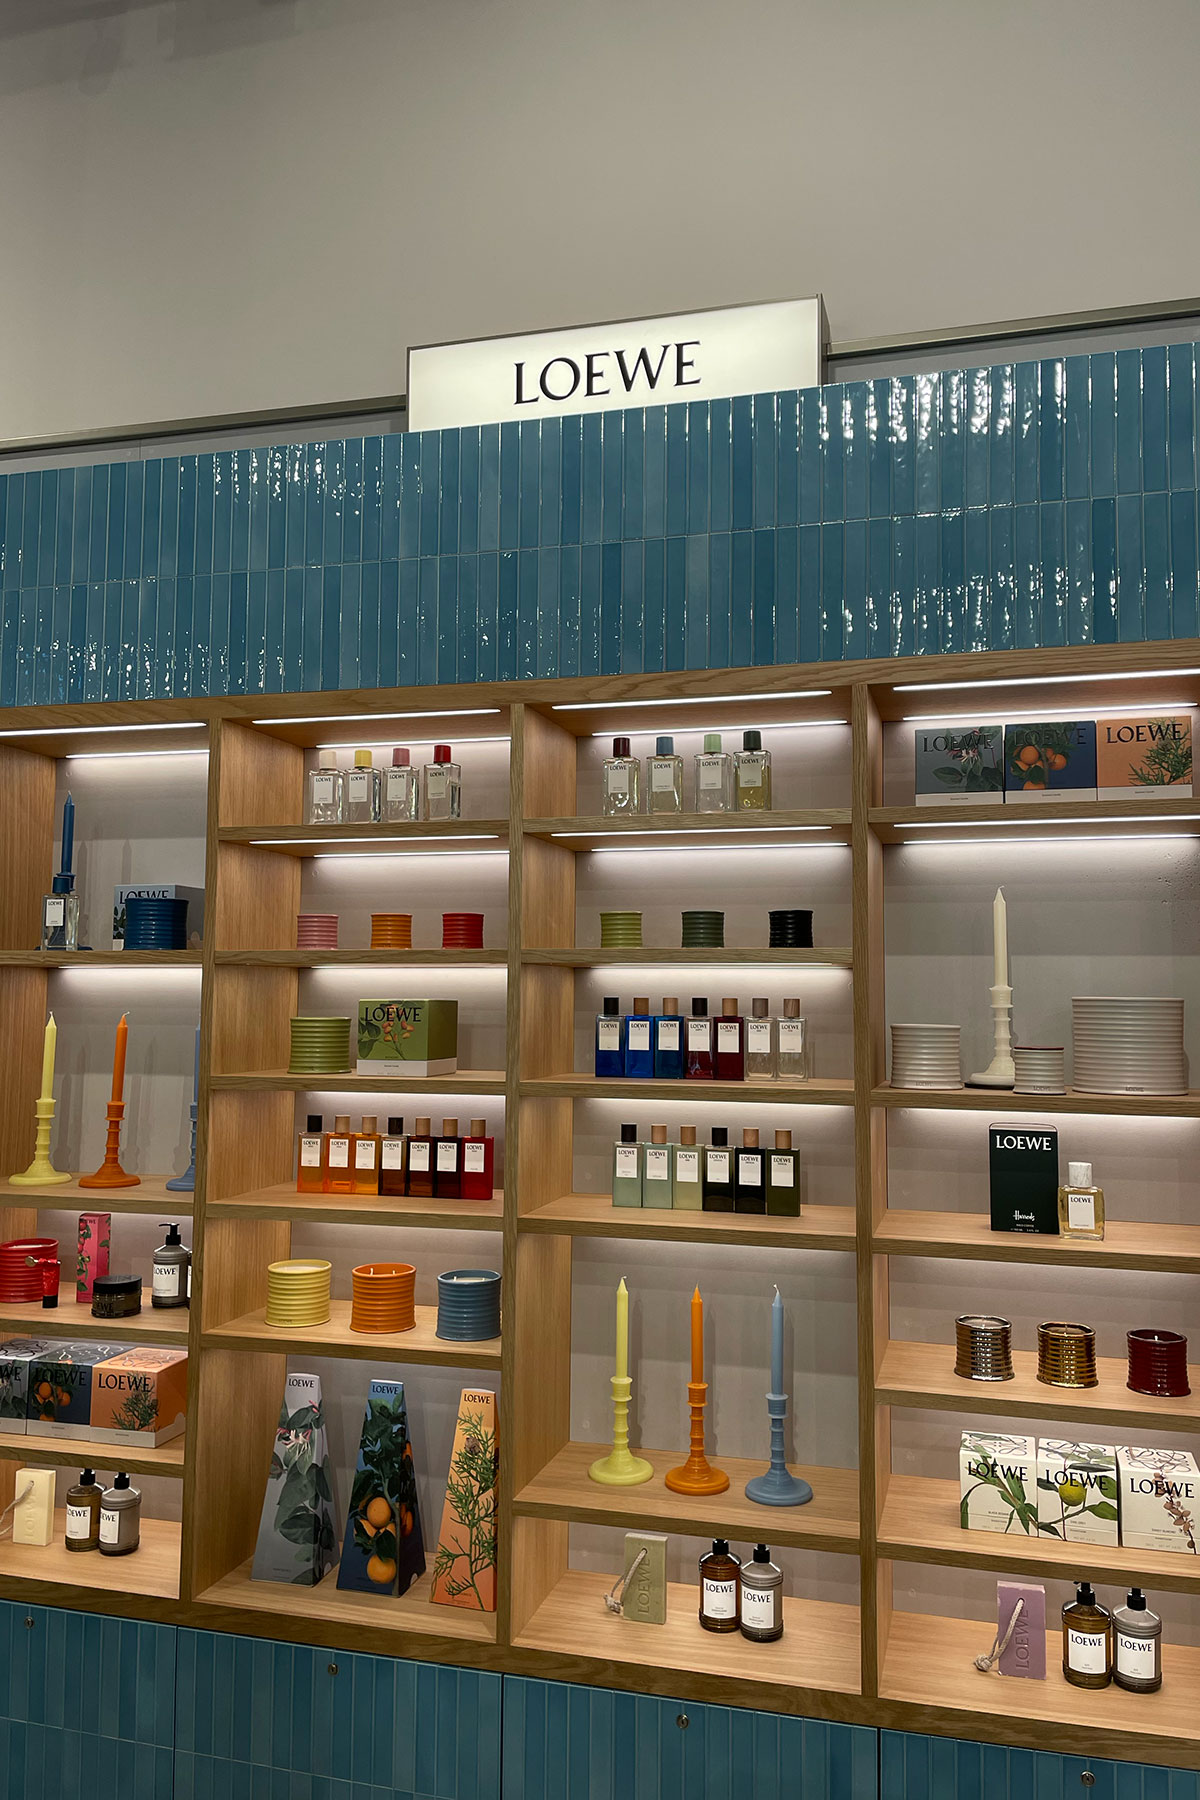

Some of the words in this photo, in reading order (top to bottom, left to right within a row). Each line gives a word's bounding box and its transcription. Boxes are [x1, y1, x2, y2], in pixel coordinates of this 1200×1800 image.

[514, 341, 702, 405] LOEWE
[923, 732, 995, 752] LOEWE
[1013, 727, 1088, 746] LOEWE
[1107, 723, 1186, 744] LOEWE
[364, 1007, 422, 1022] LOEWE
[996, 1135, 1052, 1151] LOEWE
[741, 1155, 759, 1163] LOEWE
[1013, 1210, 1035, 1222] Harrods
[35, 1367, 88, 1386] LOEWE
[98, 1373, 152, 1393] LOEWE
[288, 1379, 315, 1389] LOEWE
[372, 1385, 399, 1395] LOEWE
[463, 1393, 491, 1405] LOEWE
[967, 1461, 1029, 1482] LOEWE
[1045, 1469, 1109, 1491] LOEWE
[1129, 1477, 1195, 1499] LOEWE
[638, 1558, 651, 1616] LOEWE
[706, 1583, 734, 1594] LOEWE
[744, 1591, 772, 1603] LOEWE
[1016, 1609, 1030, 1671] LOEWE
[1071, 1633, 1103, 1647] LOEWE
[1121, 1638, 1153, 1652] LOEWE
